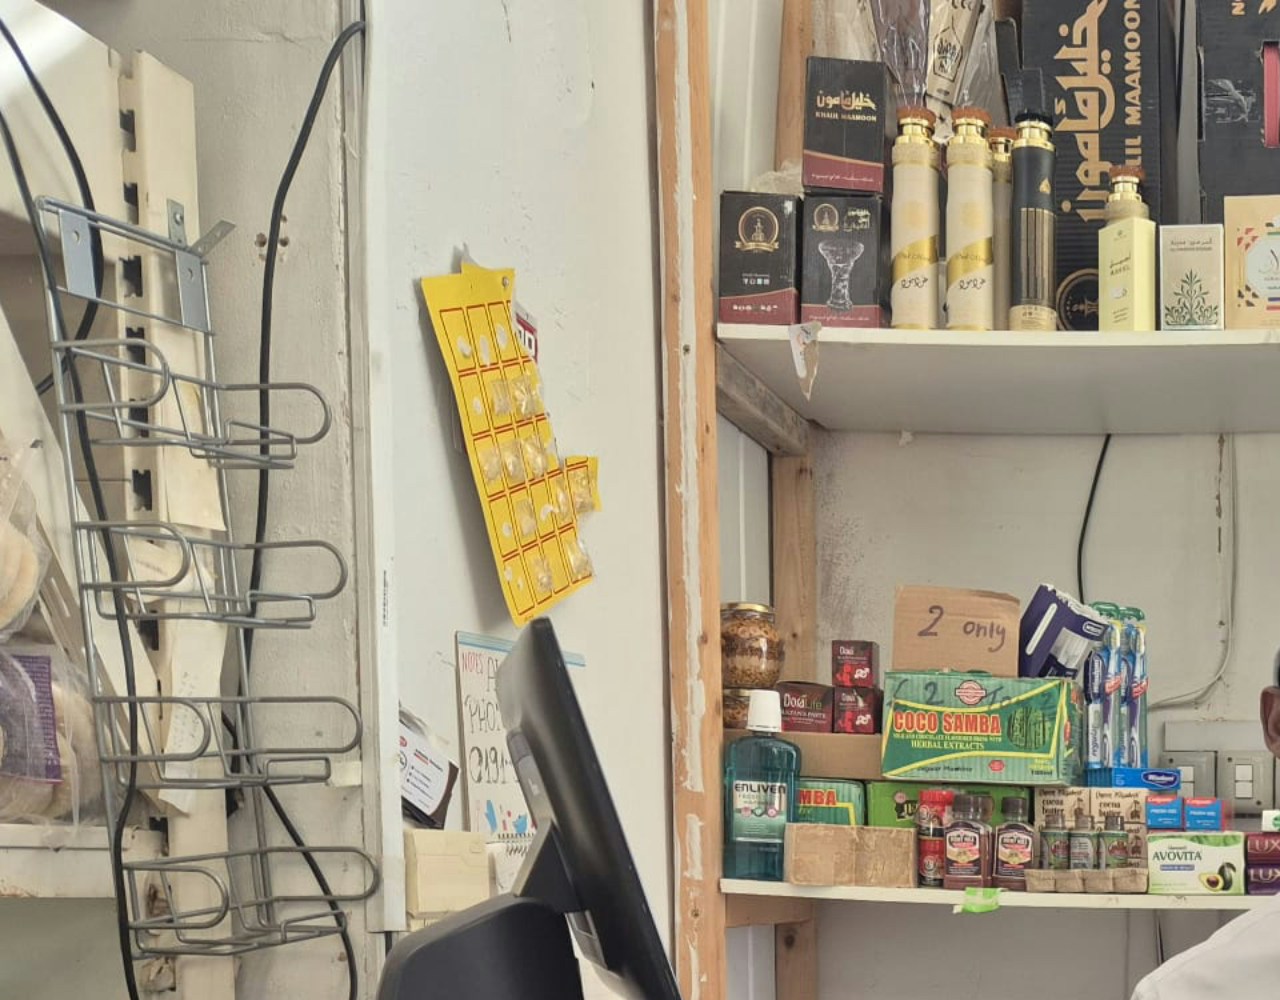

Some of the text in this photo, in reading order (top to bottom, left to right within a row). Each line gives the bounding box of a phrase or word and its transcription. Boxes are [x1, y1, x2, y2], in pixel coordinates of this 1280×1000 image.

[917, 605, 1006, 653] 2 only
[893, 710, 1002, 735] COCO SAMBA
[944, 741, 985, 750] EXTRACTS
[798, 789, 837, 805] MBA
[1247, 841, 1280, 853] LUX
[1152, 849, 1202, 862] AVOVITA
